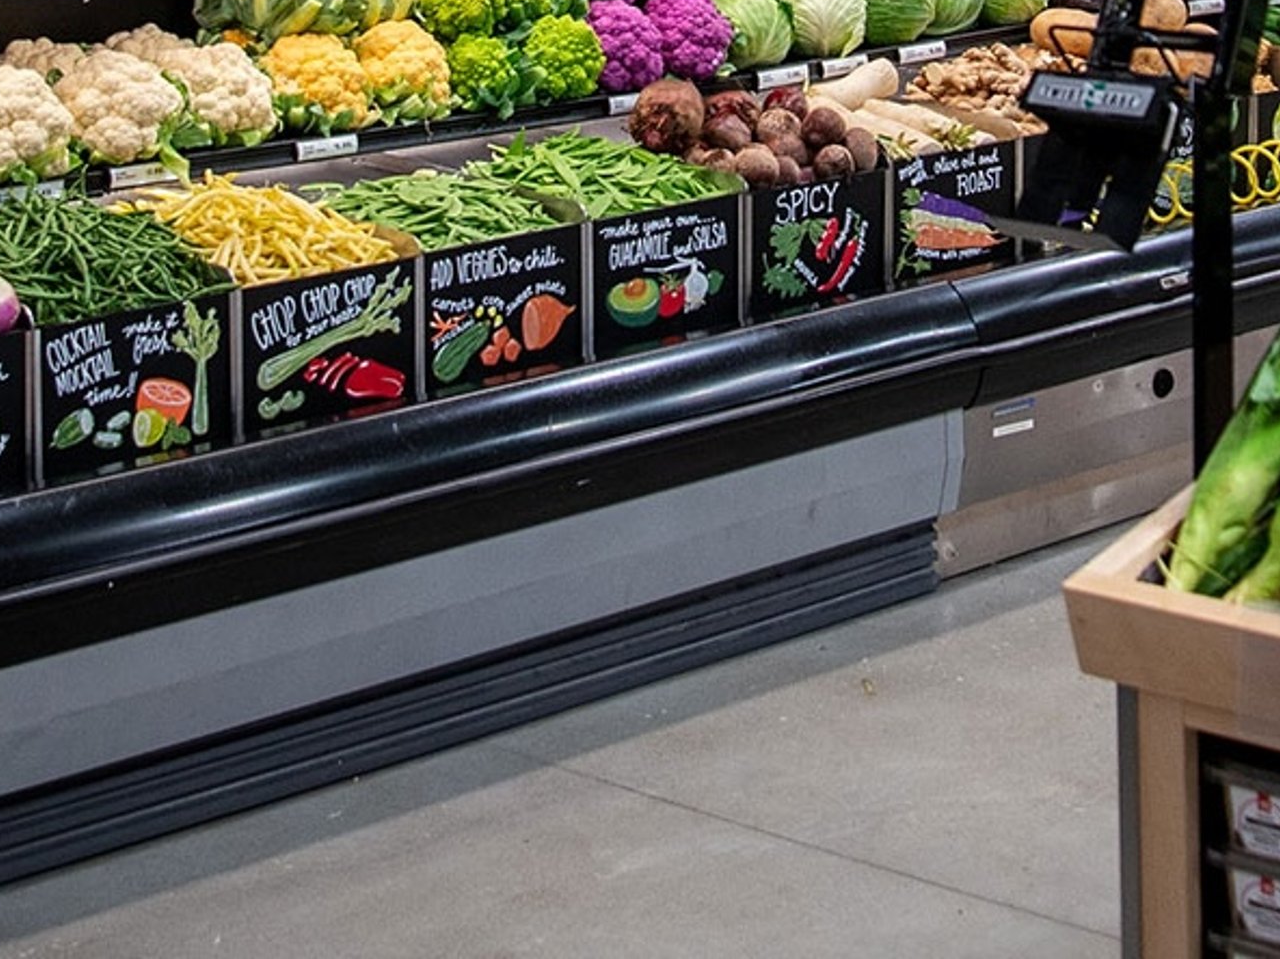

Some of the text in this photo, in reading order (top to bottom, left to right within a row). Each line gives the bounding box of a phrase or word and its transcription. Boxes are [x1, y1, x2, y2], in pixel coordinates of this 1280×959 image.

[775, 181, 840, 225] SPICY
[956, 166, 1004, 197] ROAST
[599, 218, 639, 240] make
[692, 220, 728, 253] SALSA
[430, 258, 454, 291] ADD
[456, 244, 509, 285] VEGGIES
[251, 273, 377, 351] CHOP CHOP CHOP
[45, 322, 112, 373] COCKTAIL
[54, 348, 120, 398] MOCKTAIL
